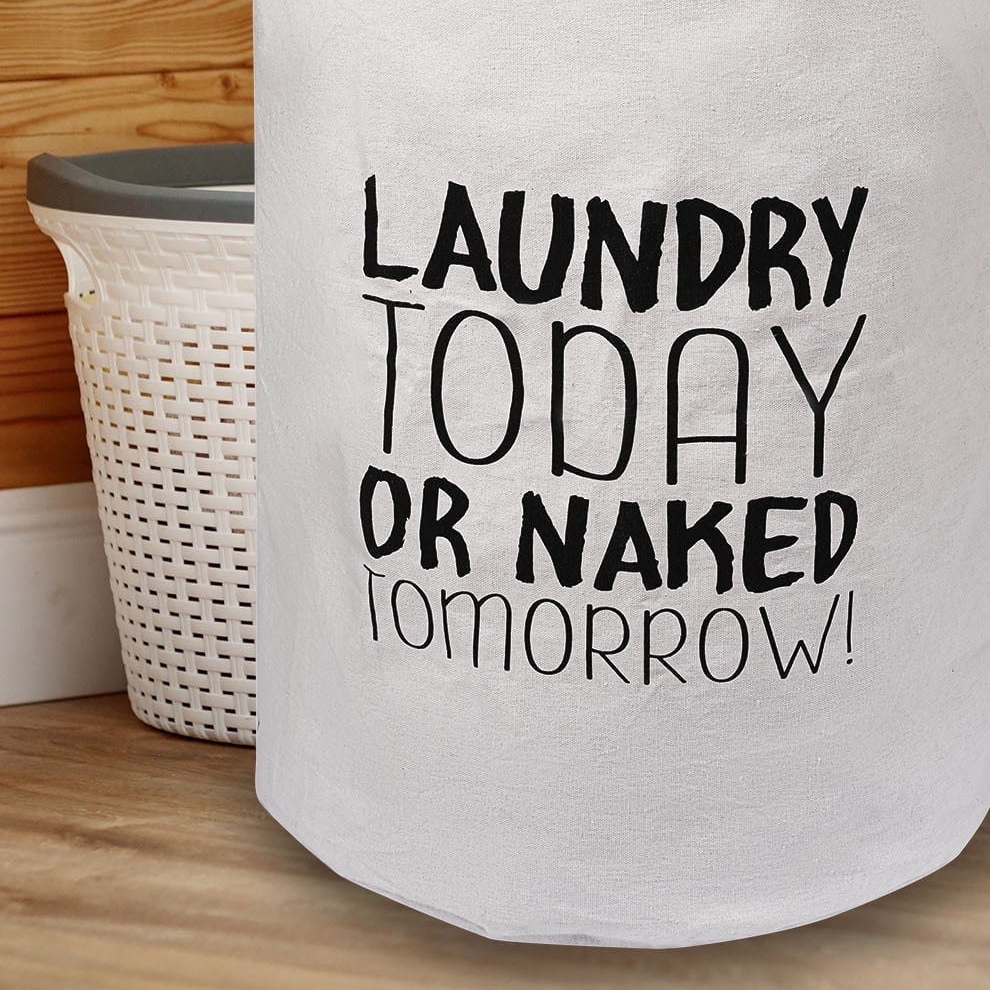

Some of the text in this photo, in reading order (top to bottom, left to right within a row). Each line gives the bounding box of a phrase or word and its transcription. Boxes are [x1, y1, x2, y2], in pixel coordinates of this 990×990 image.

[362, 174, 869, 314] LAUNDRY
[361, 293, 868, 486] TODAY
[359, 464, 859, 595] OR NAKED
[363, 563, 854, 686] TOMORROW!
